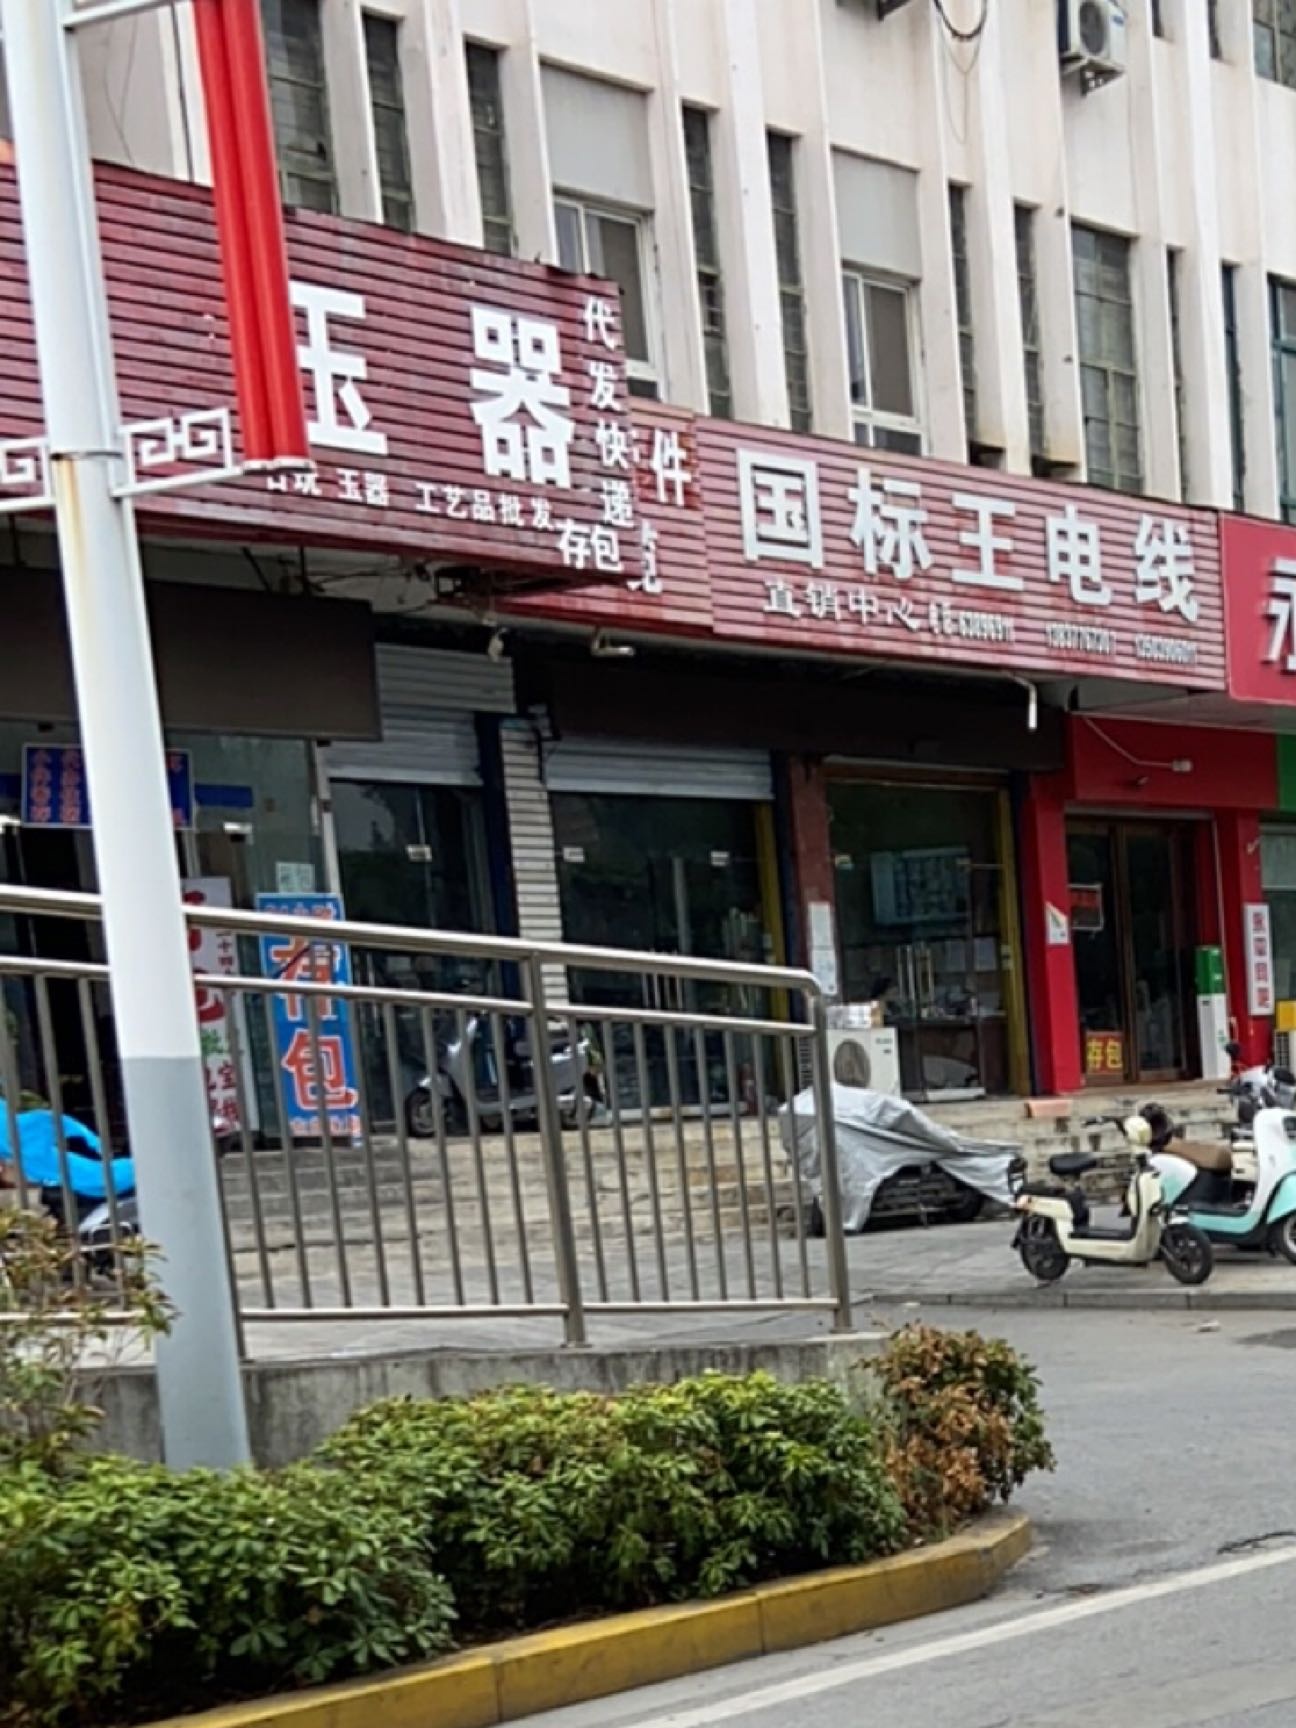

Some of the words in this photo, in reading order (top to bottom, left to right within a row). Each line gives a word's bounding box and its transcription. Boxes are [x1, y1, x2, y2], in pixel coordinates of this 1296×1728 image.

[338, 467, 390, 507] 玉器
[415, 480, 555, 532] 工艺品批发
[556, 517, 625, 572] 存包
[736, 447, 1200, 624] 国标王电线
[762, 577, 923, 633] 直销中心
